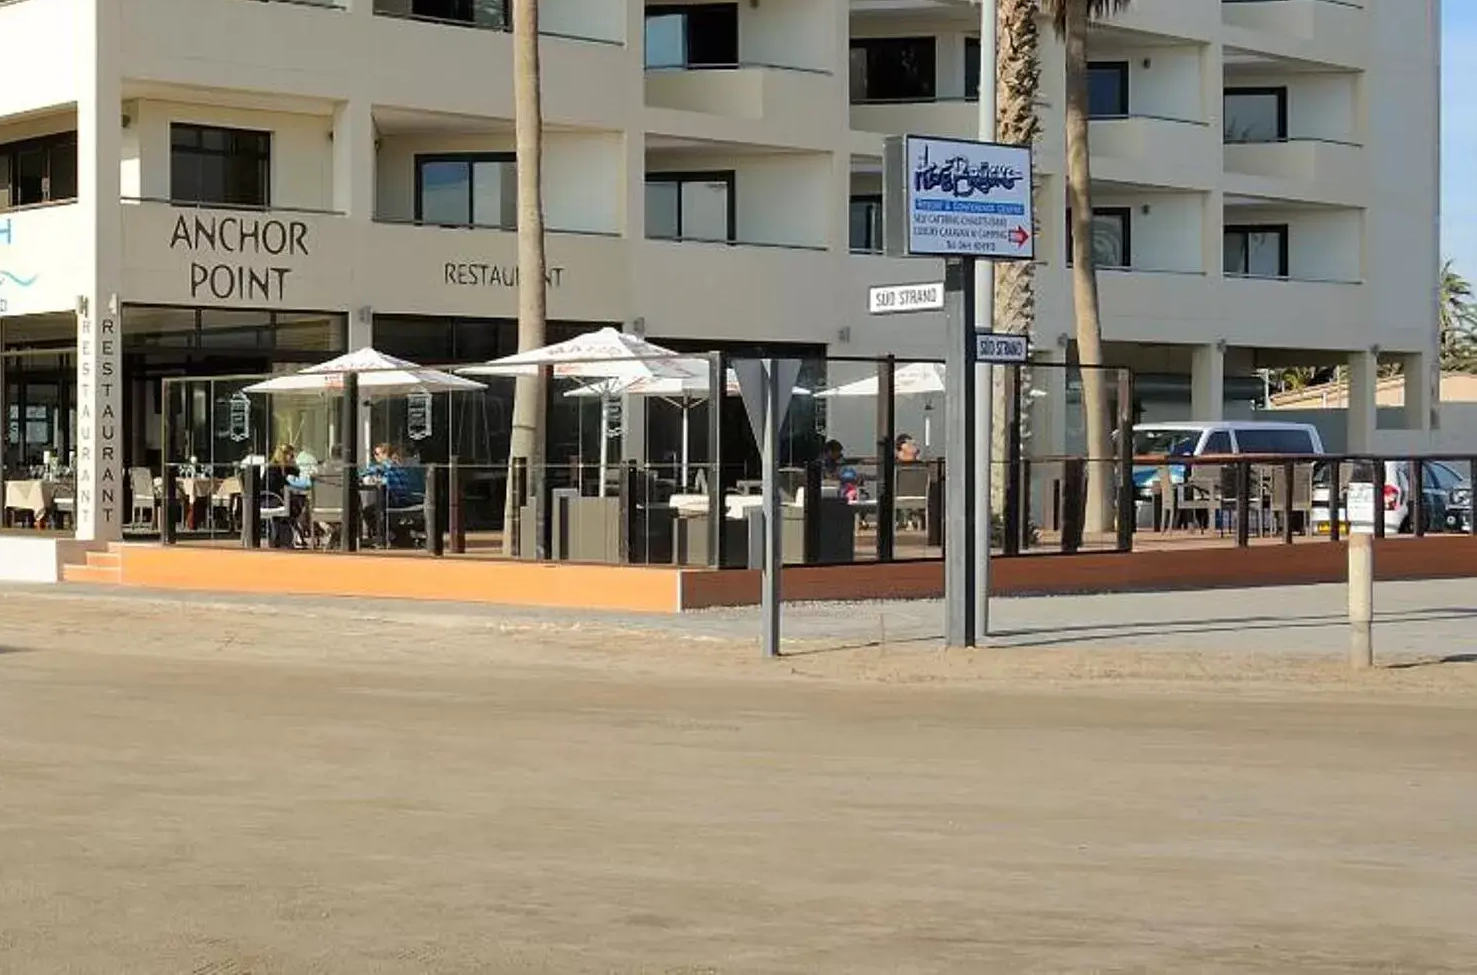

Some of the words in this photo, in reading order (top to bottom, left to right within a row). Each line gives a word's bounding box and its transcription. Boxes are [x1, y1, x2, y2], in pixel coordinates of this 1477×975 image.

[169, 213, 309, 256] ANCHOR
[191, 261, 292, 301] POINT
[444, 262, 565, 287] RESTAUNT
[80, 320, 92, 524] RESTAURANT
[101, 319, 115, 523] RESTAURANT
